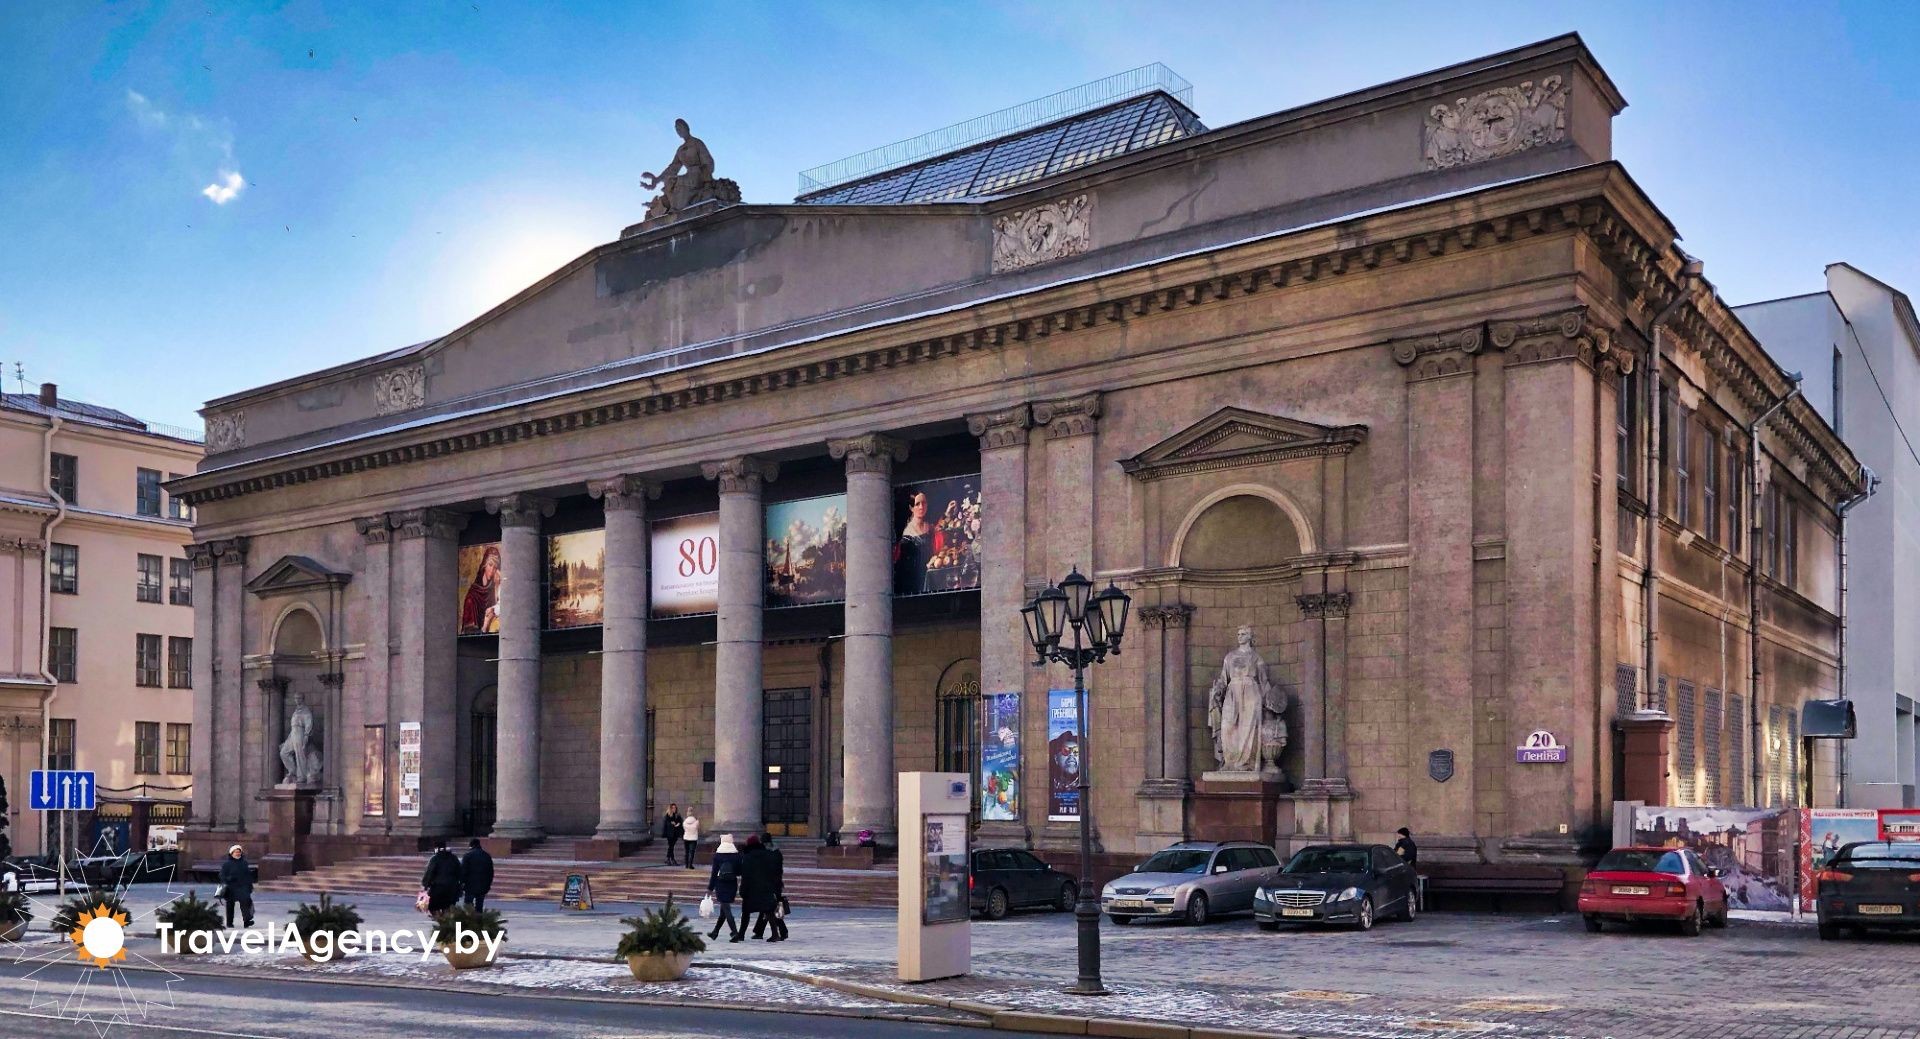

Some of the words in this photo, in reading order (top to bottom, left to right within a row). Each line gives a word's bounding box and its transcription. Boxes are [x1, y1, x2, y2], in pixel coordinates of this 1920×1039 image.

[679, 536, 717, 577] 80
[1532, 733, 1550, 747] 20
[1523, 751, 1560, 761] Леніна
